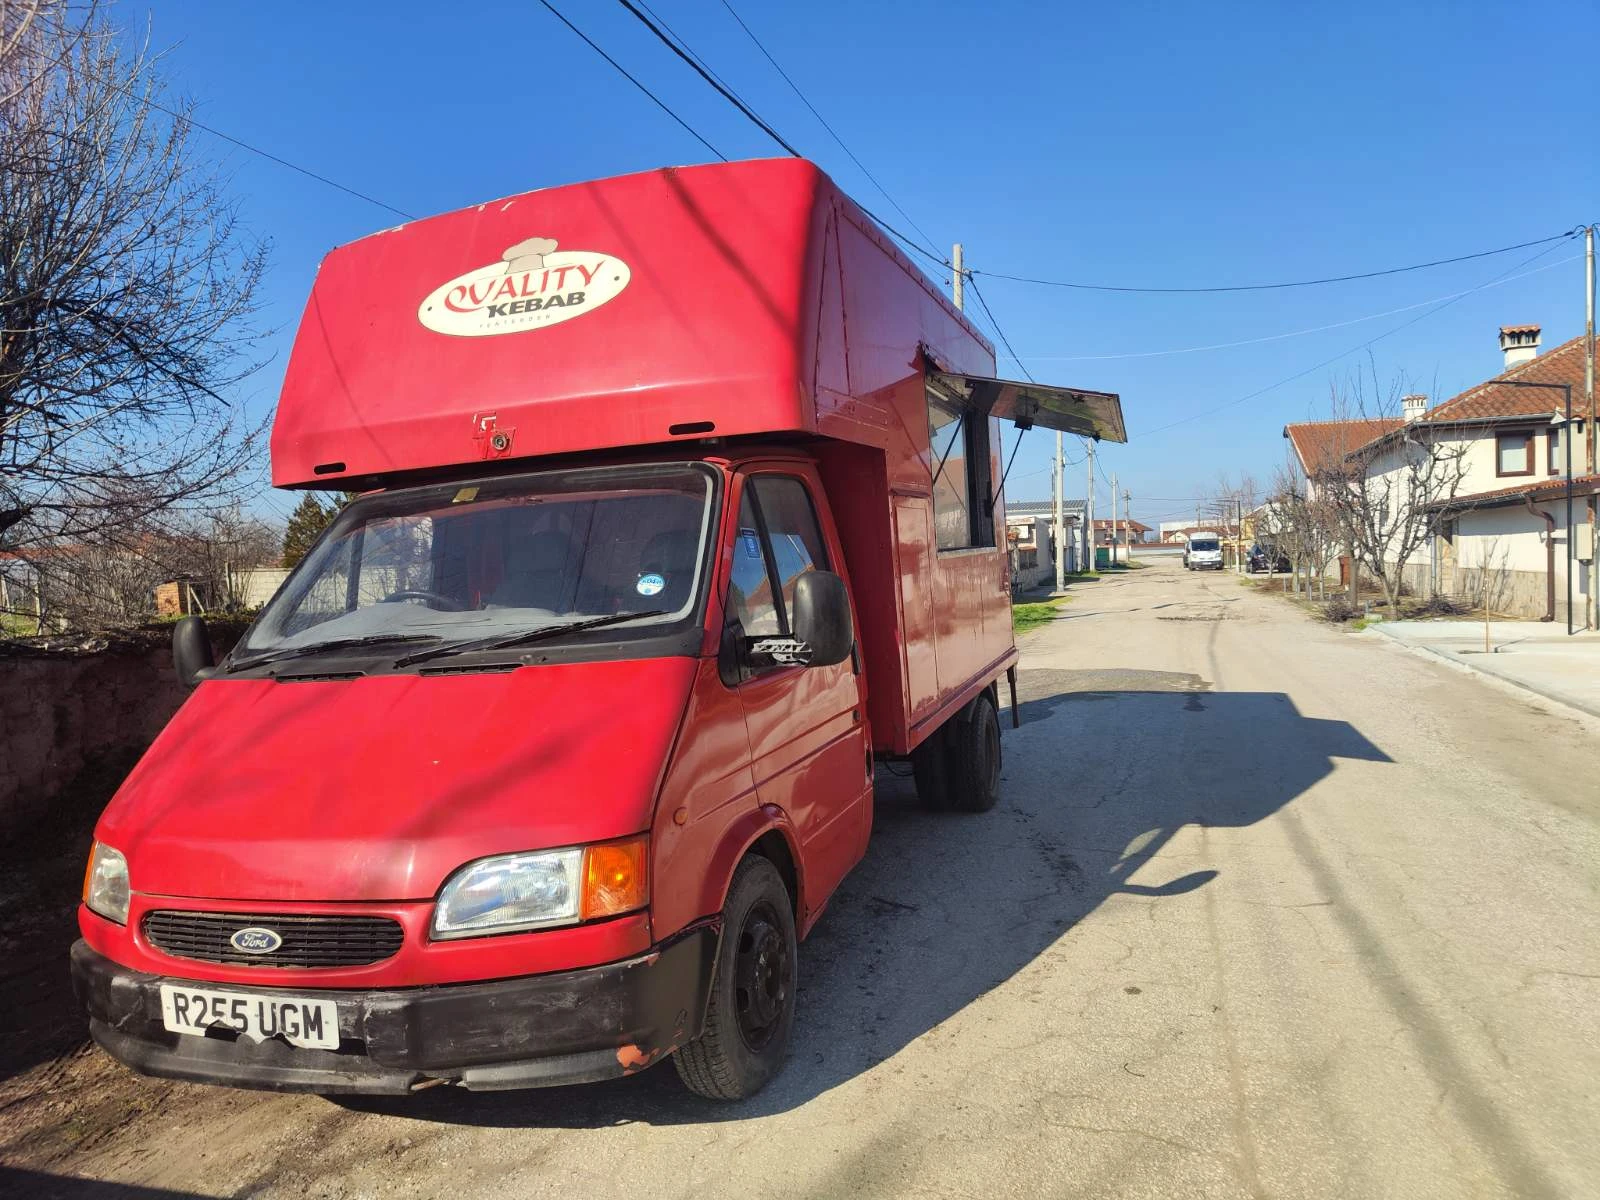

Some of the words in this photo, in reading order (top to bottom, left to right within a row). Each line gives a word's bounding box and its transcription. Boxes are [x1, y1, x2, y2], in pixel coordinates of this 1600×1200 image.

[445, 260, 606, 313] QUALITY
[487, 291, 585, 318] KEBAB
[241, 932, 269, 948] Ford
[173, 992, 249, 1034] R255
[258, 1001, 323, 1041] UGM
